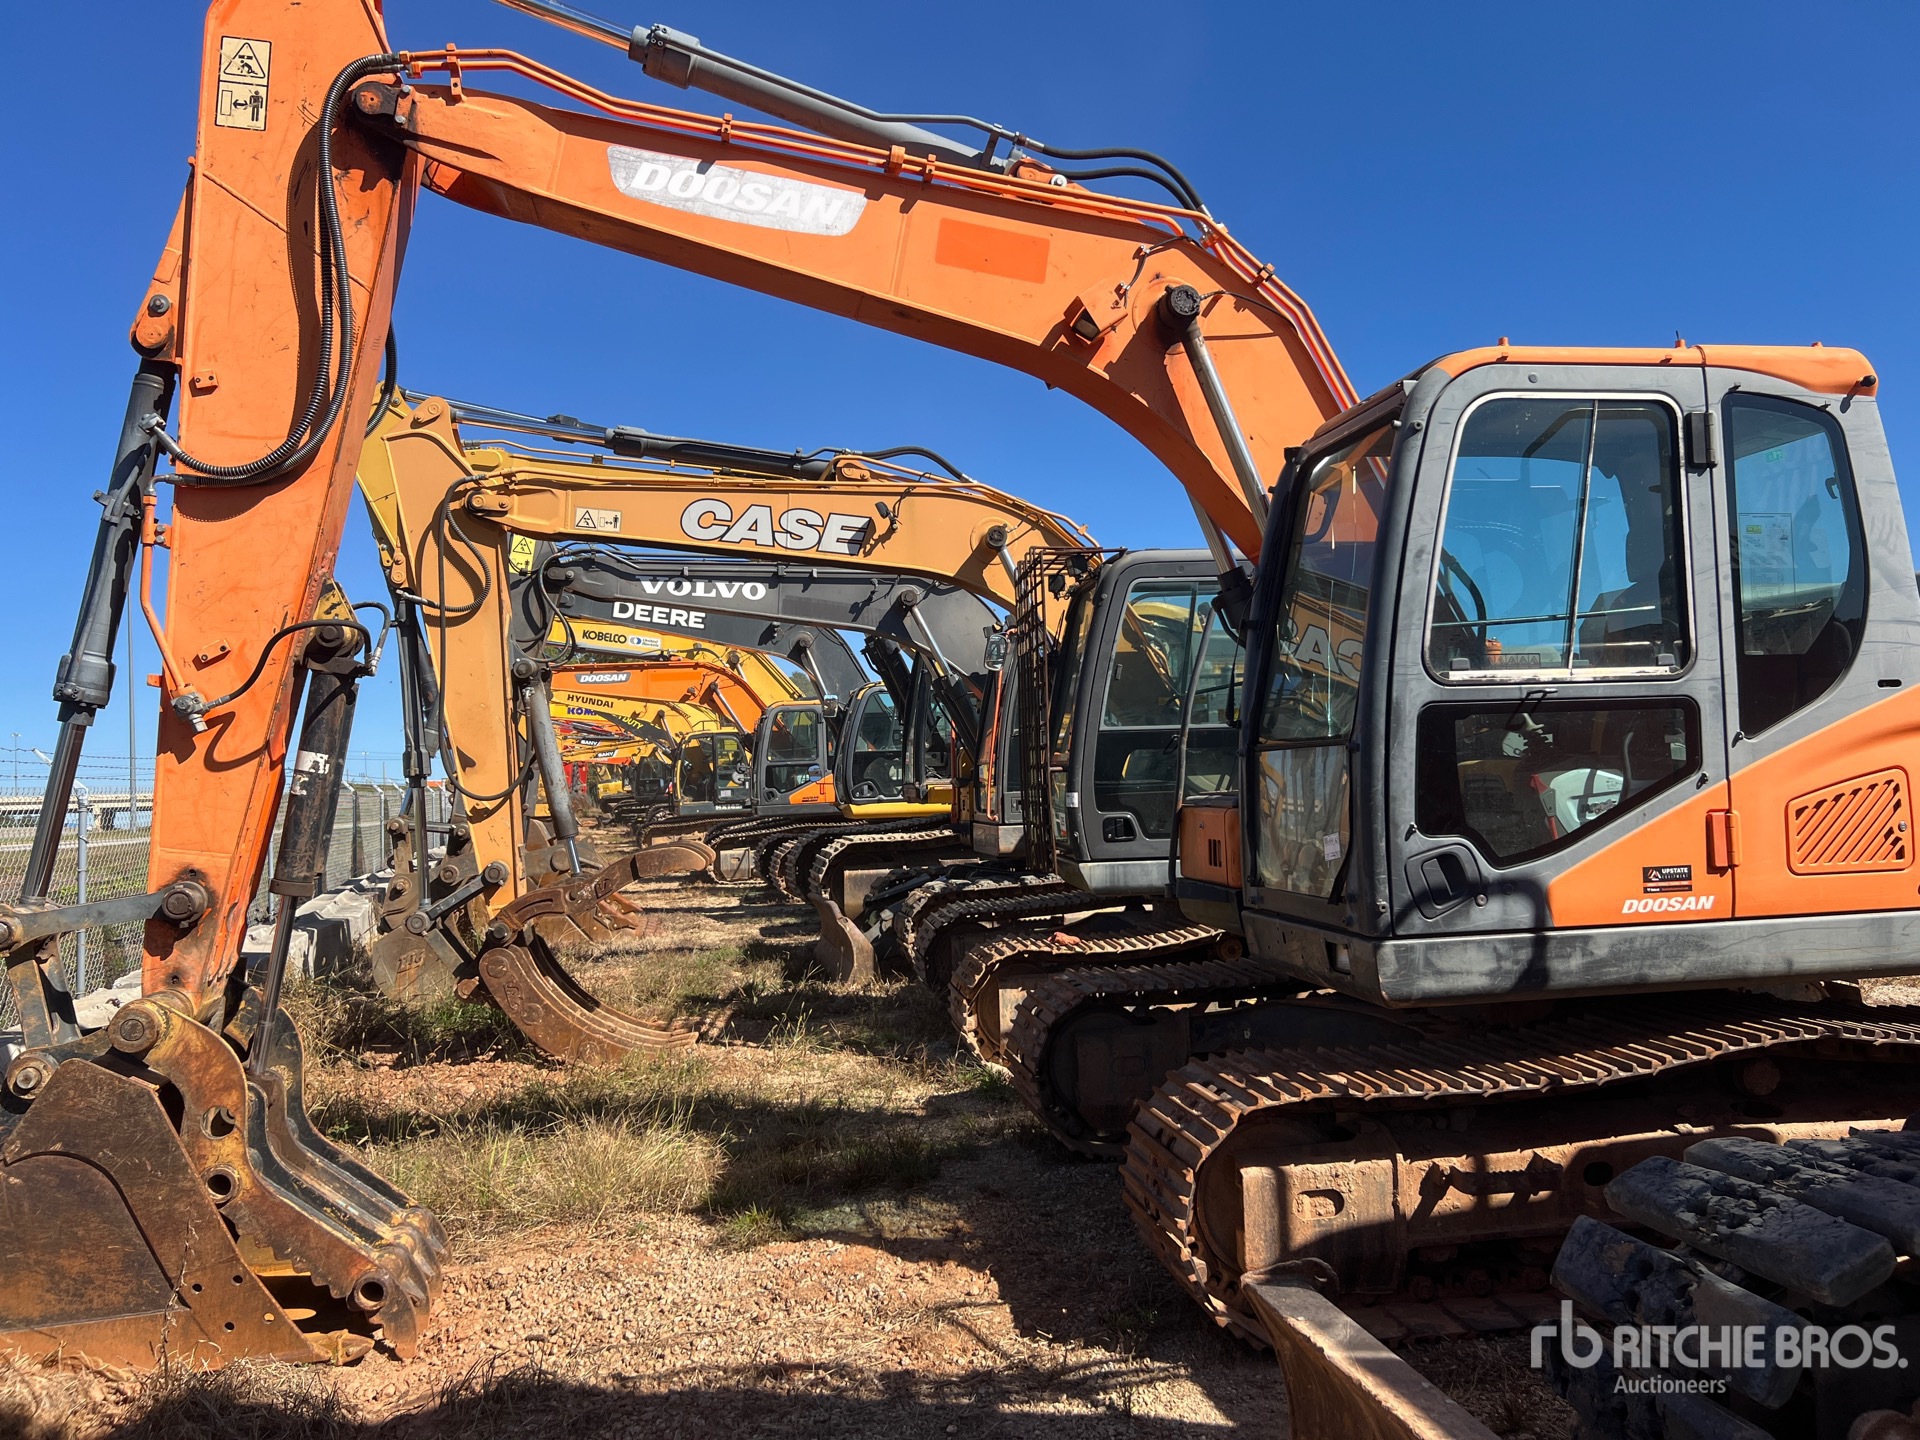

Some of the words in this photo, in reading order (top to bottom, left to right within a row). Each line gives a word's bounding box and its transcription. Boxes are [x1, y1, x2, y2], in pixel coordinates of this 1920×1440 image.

[630, 161, 847, 224] DOOSAN
[680, 498, 872, 556] CASE
[635, 575, 767, 601] VOLVO
[612, 601, 706, 629] DEERE
[582, 629, 627, 644] KOBELCO
[580, 673, 627, 683] DOOSAN
[567, 693, 614, 709] HYUNDAI
[1621, 895, 1715, 914] DOOSAN
